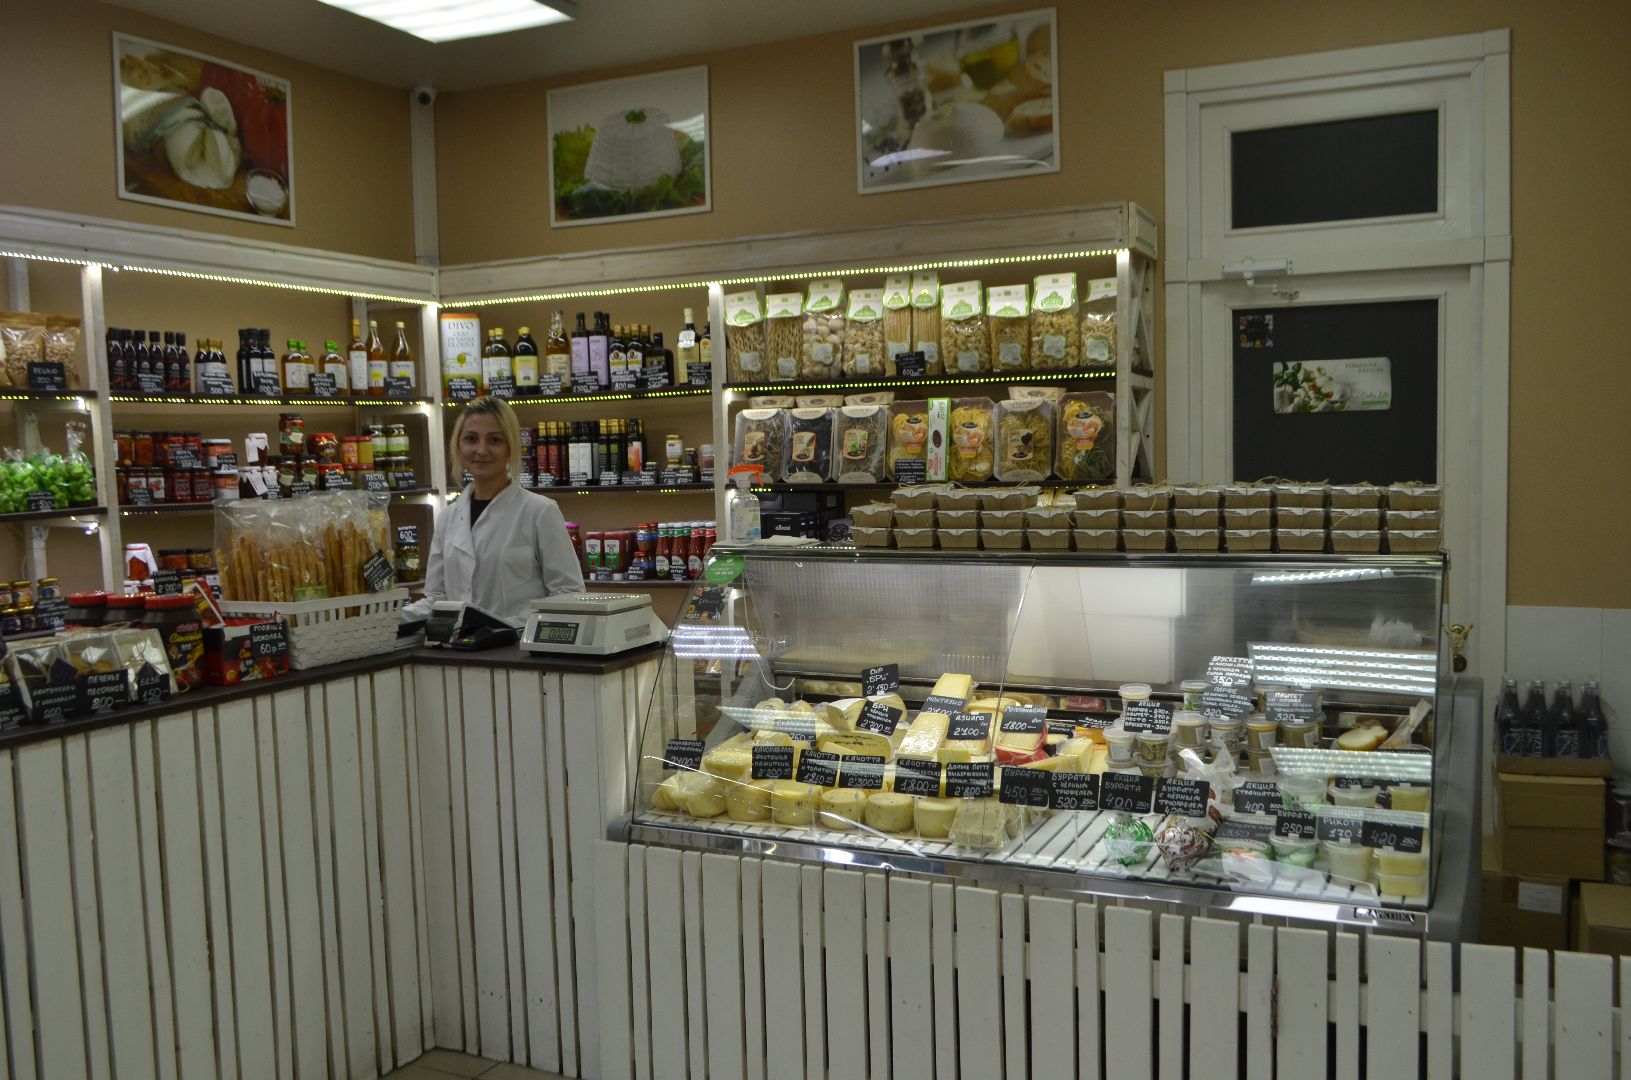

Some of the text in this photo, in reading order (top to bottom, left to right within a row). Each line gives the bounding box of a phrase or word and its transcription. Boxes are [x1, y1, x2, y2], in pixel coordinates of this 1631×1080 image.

[448, 322, 474, 330] DIVO
[1211, 656, 1253, 664] БРУСКЕТТА
[88, 673, 122, 685] ПЕЧЕНЬЕ
[141, 677, 162, 687] БЕЗЕ
[1210, 676, 1233, 684] 350
[88, 683, 126, 696] ПЕСОЧНОЕ
[955, 714, 985, 722] АЗИАГО
[1274, 713, 1296, 722] 320
[805, 750, 836, 760] КАЧОТТА
[845, 755, 881, 763] КАЧОТТА
[899, 760, 938, 769] КАЧОТТА
[1004, 768, 1046, 779] БУРРАТА
[1051, 772, 1091, 781] БУРРАТА
[1113, 774, 1140, 784] АКЦИЯ
[1166, 777, 1196, 787] АКЦИЯ
[1004, 784, 1027, 798] 450
[1104, 781, 1142, 792] БУРРАТА
[1161, 785, 1200, 795] БУРРАТА
[1246, 782, 1275, 790] АКЦИЯ
[1055, 796, 1078, 809] 520
[1105, 793, 1133, 808] 400
[1244, 801, 1265, 813] 400
[1277, 810, 1314, 820] БУРРАТА
[1281, 822, 1303, 834] 250
